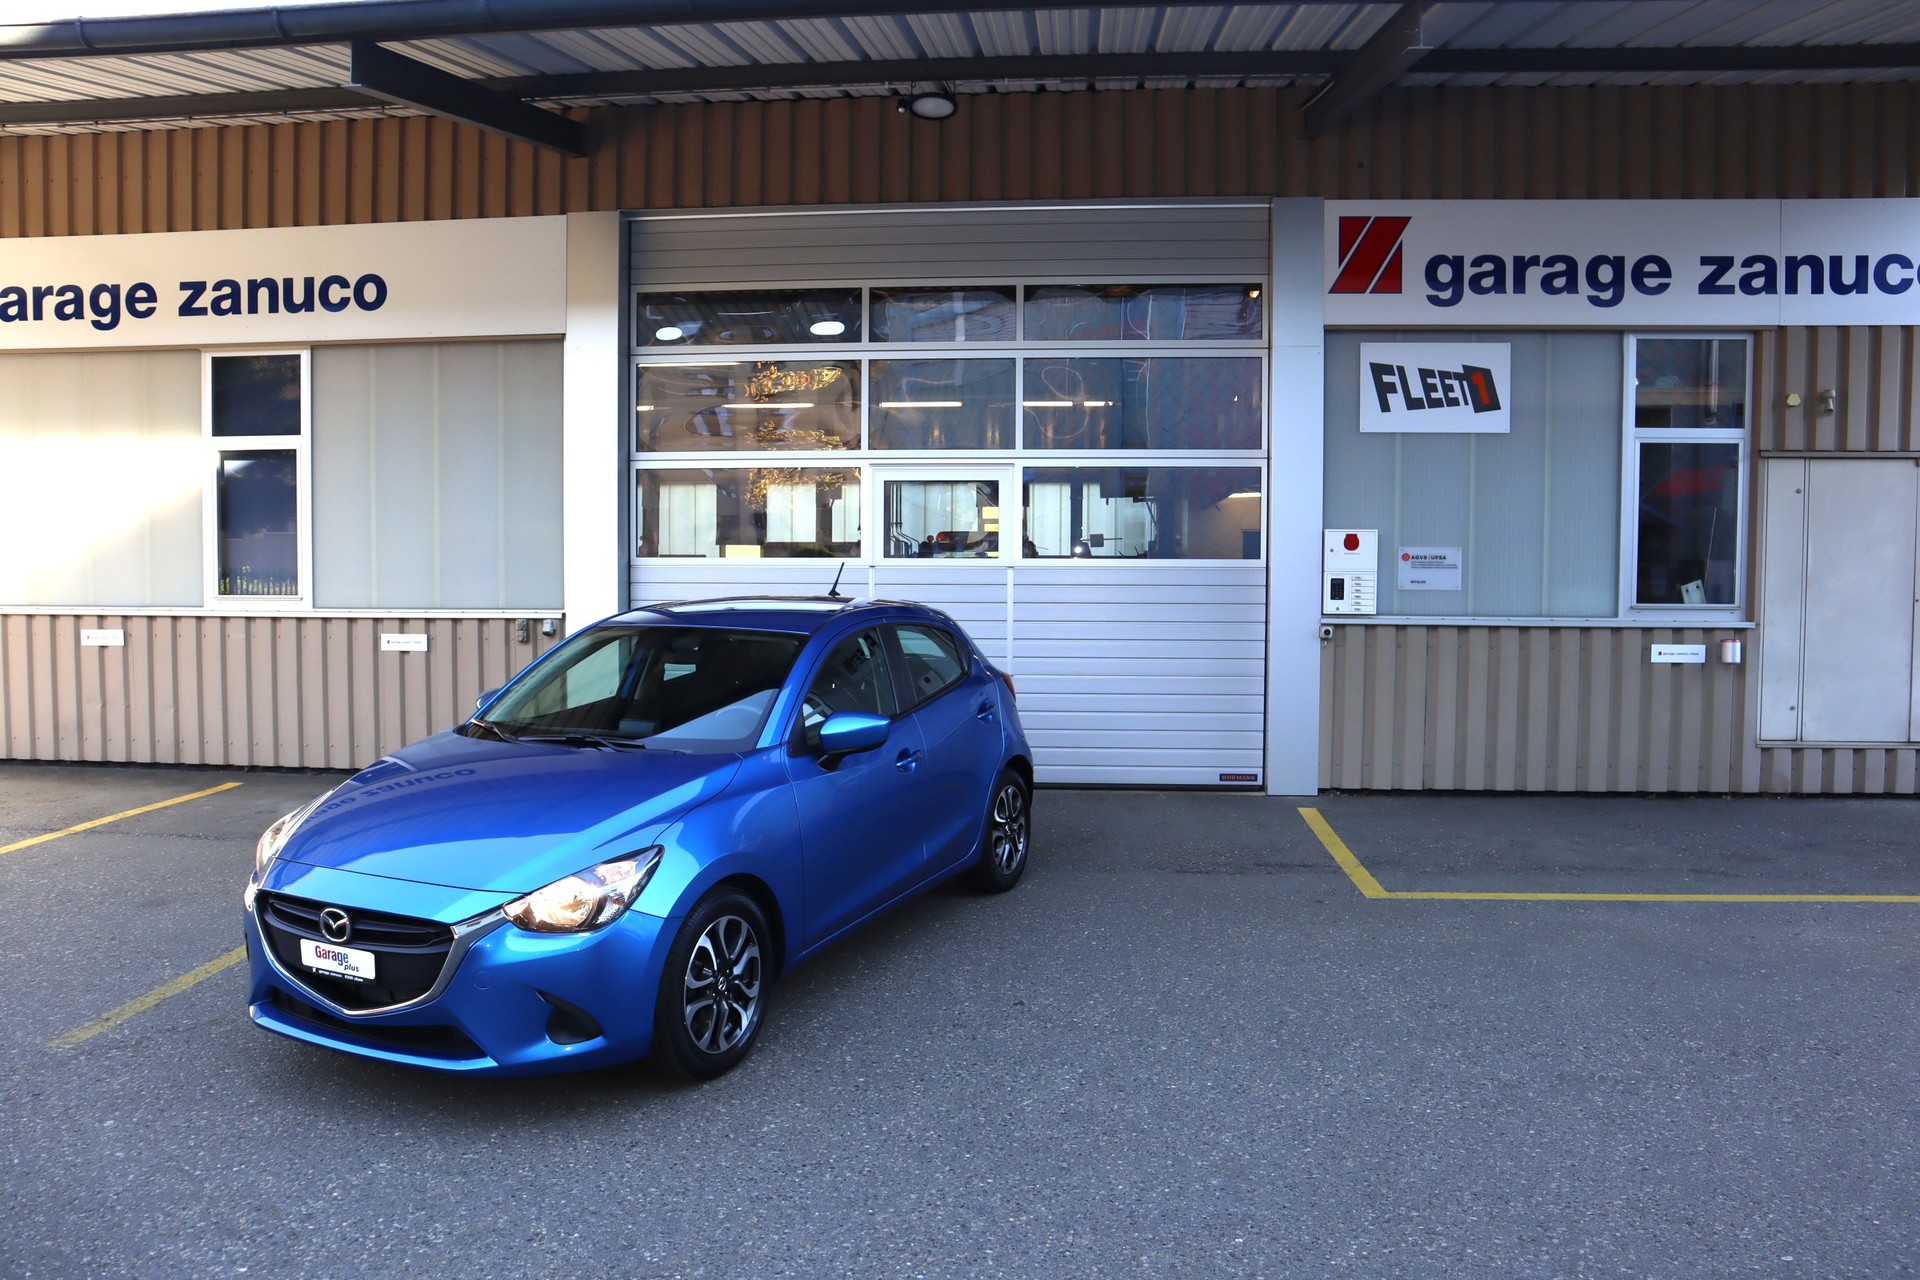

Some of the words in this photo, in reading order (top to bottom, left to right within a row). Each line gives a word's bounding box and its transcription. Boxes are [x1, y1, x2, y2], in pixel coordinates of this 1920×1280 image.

[178, 273, 388, 317] zanuco
[1424, 253, 1672, 308] garage
[1698, 253, 1920, 296] zanuc
[315, 945, 349, 966] Garage
[344, 963, 360, 973] plus
